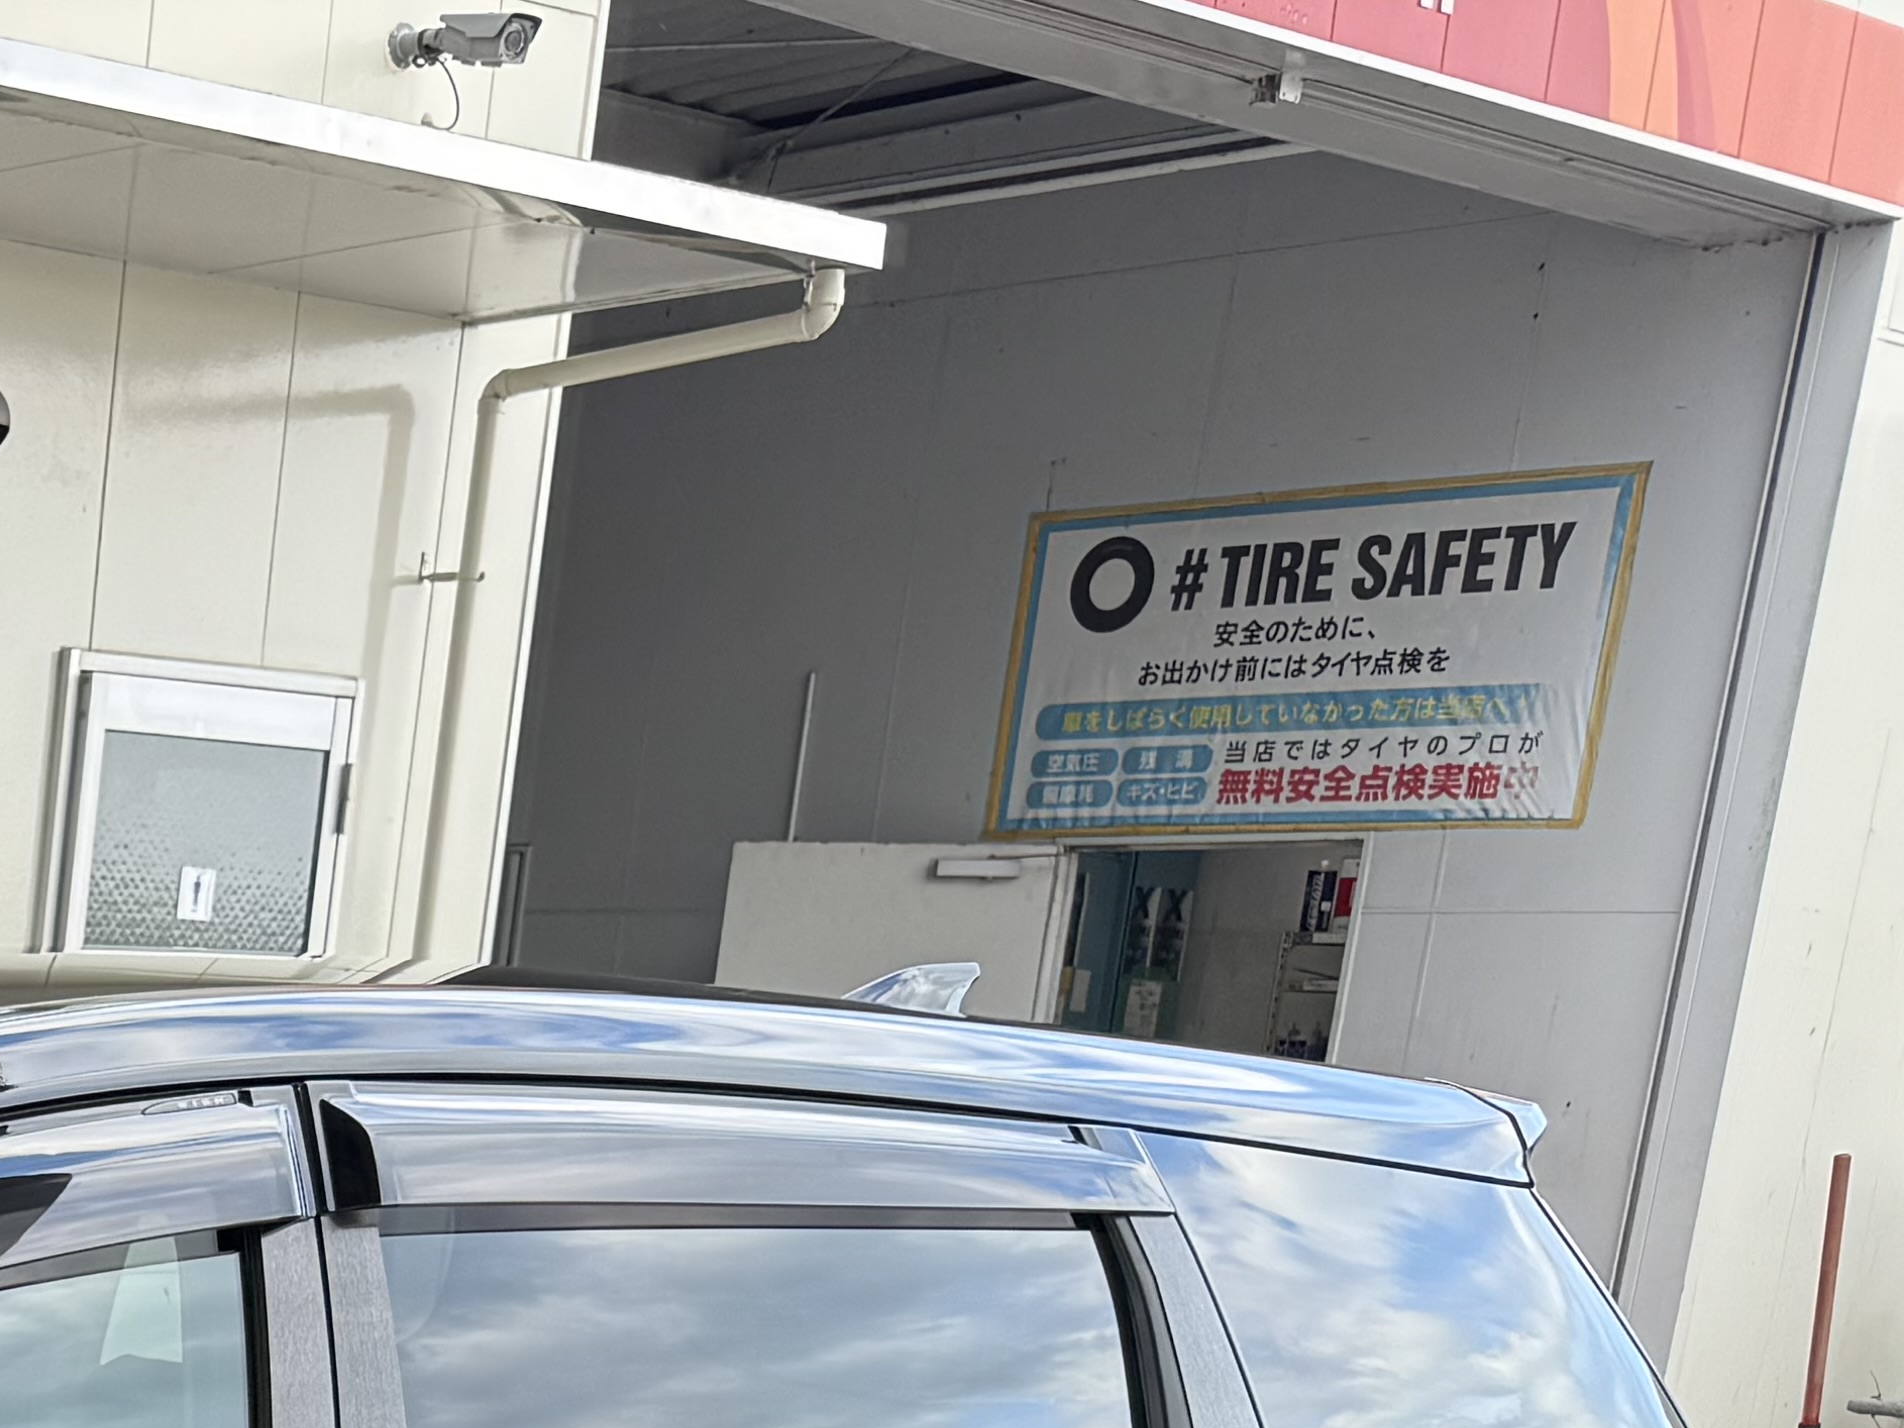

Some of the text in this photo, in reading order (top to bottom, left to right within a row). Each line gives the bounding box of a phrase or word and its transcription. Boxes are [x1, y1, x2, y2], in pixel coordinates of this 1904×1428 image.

[1219, 537, 1341, 608] TIRE
[1350, 521, 1578, 602] SAFETY
[1213, 615, 1377, 648] 安全のために、
[1137, 645, 1450, 687] お出かけ前にはタイヤ点検を
[1224, 731, 1544, 765] 当店ではタイヤのプロが
